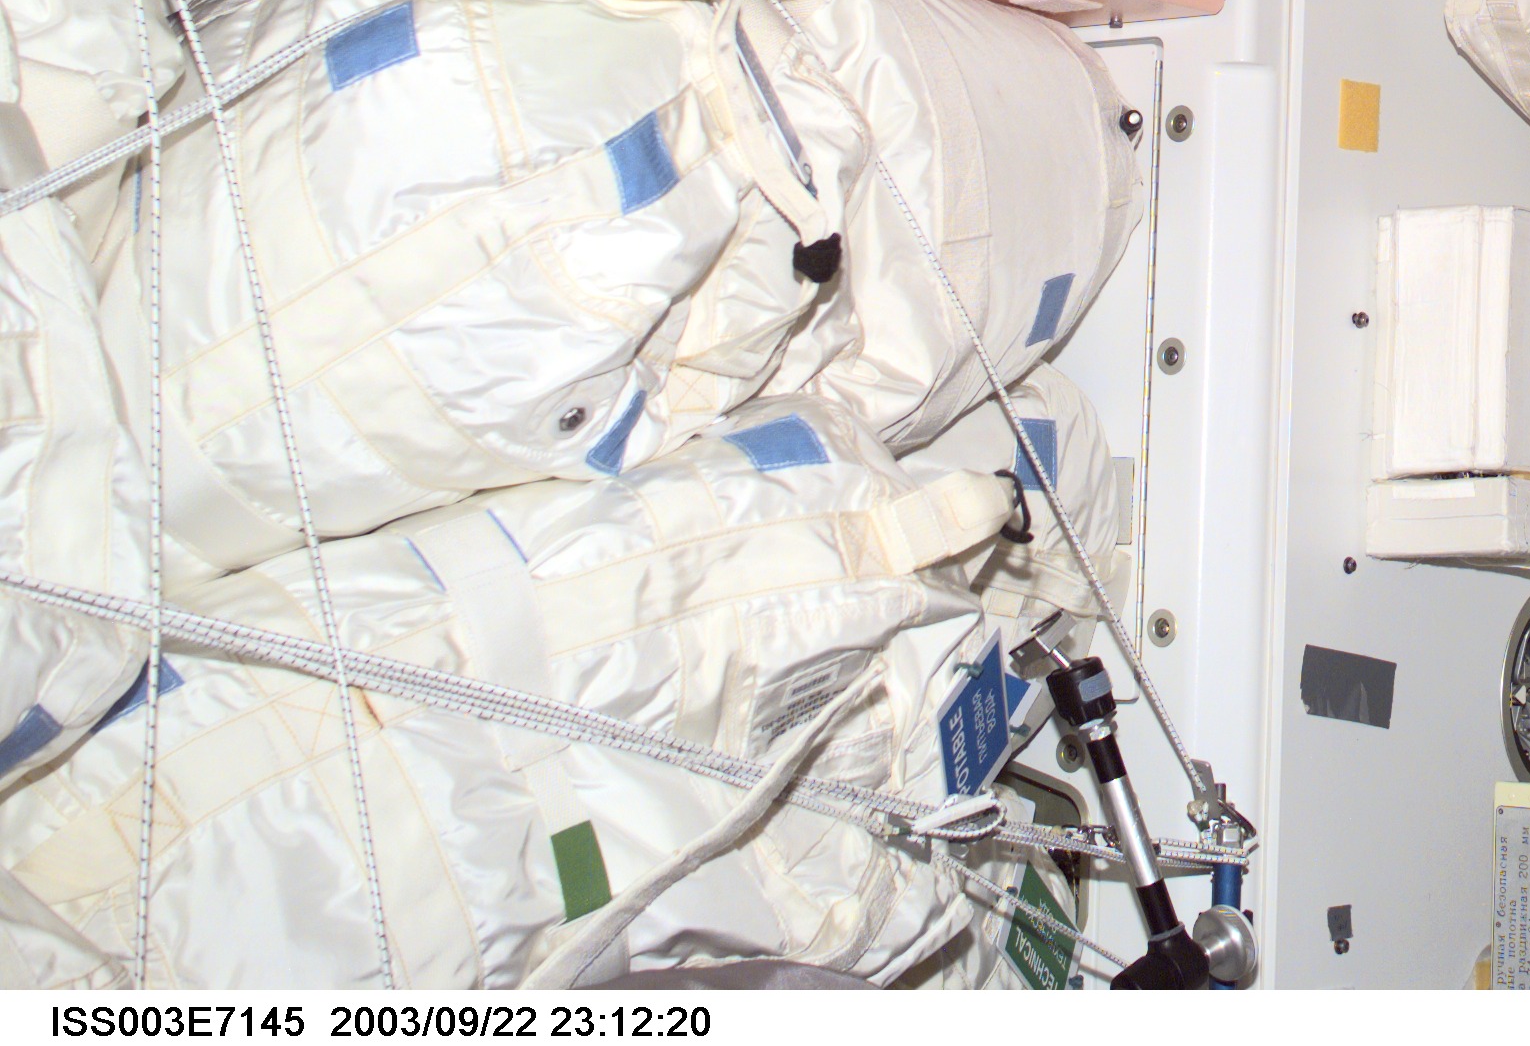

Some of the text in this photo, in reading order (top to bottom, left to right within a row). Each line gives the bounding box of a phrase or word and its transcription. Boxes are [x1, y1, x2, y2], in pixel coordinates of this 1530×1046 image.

[971, 687, 988, 765] ПИТЬЕВАЯ
[984, 688, 997, 734] ВОДА
[948, 705, 972, 795] POTABLE
[1518, 854, 1529, 880] 200
[1496, 836, 1508, 985] ручная безопасная
[1508, 899, 1517, 958] полотна
